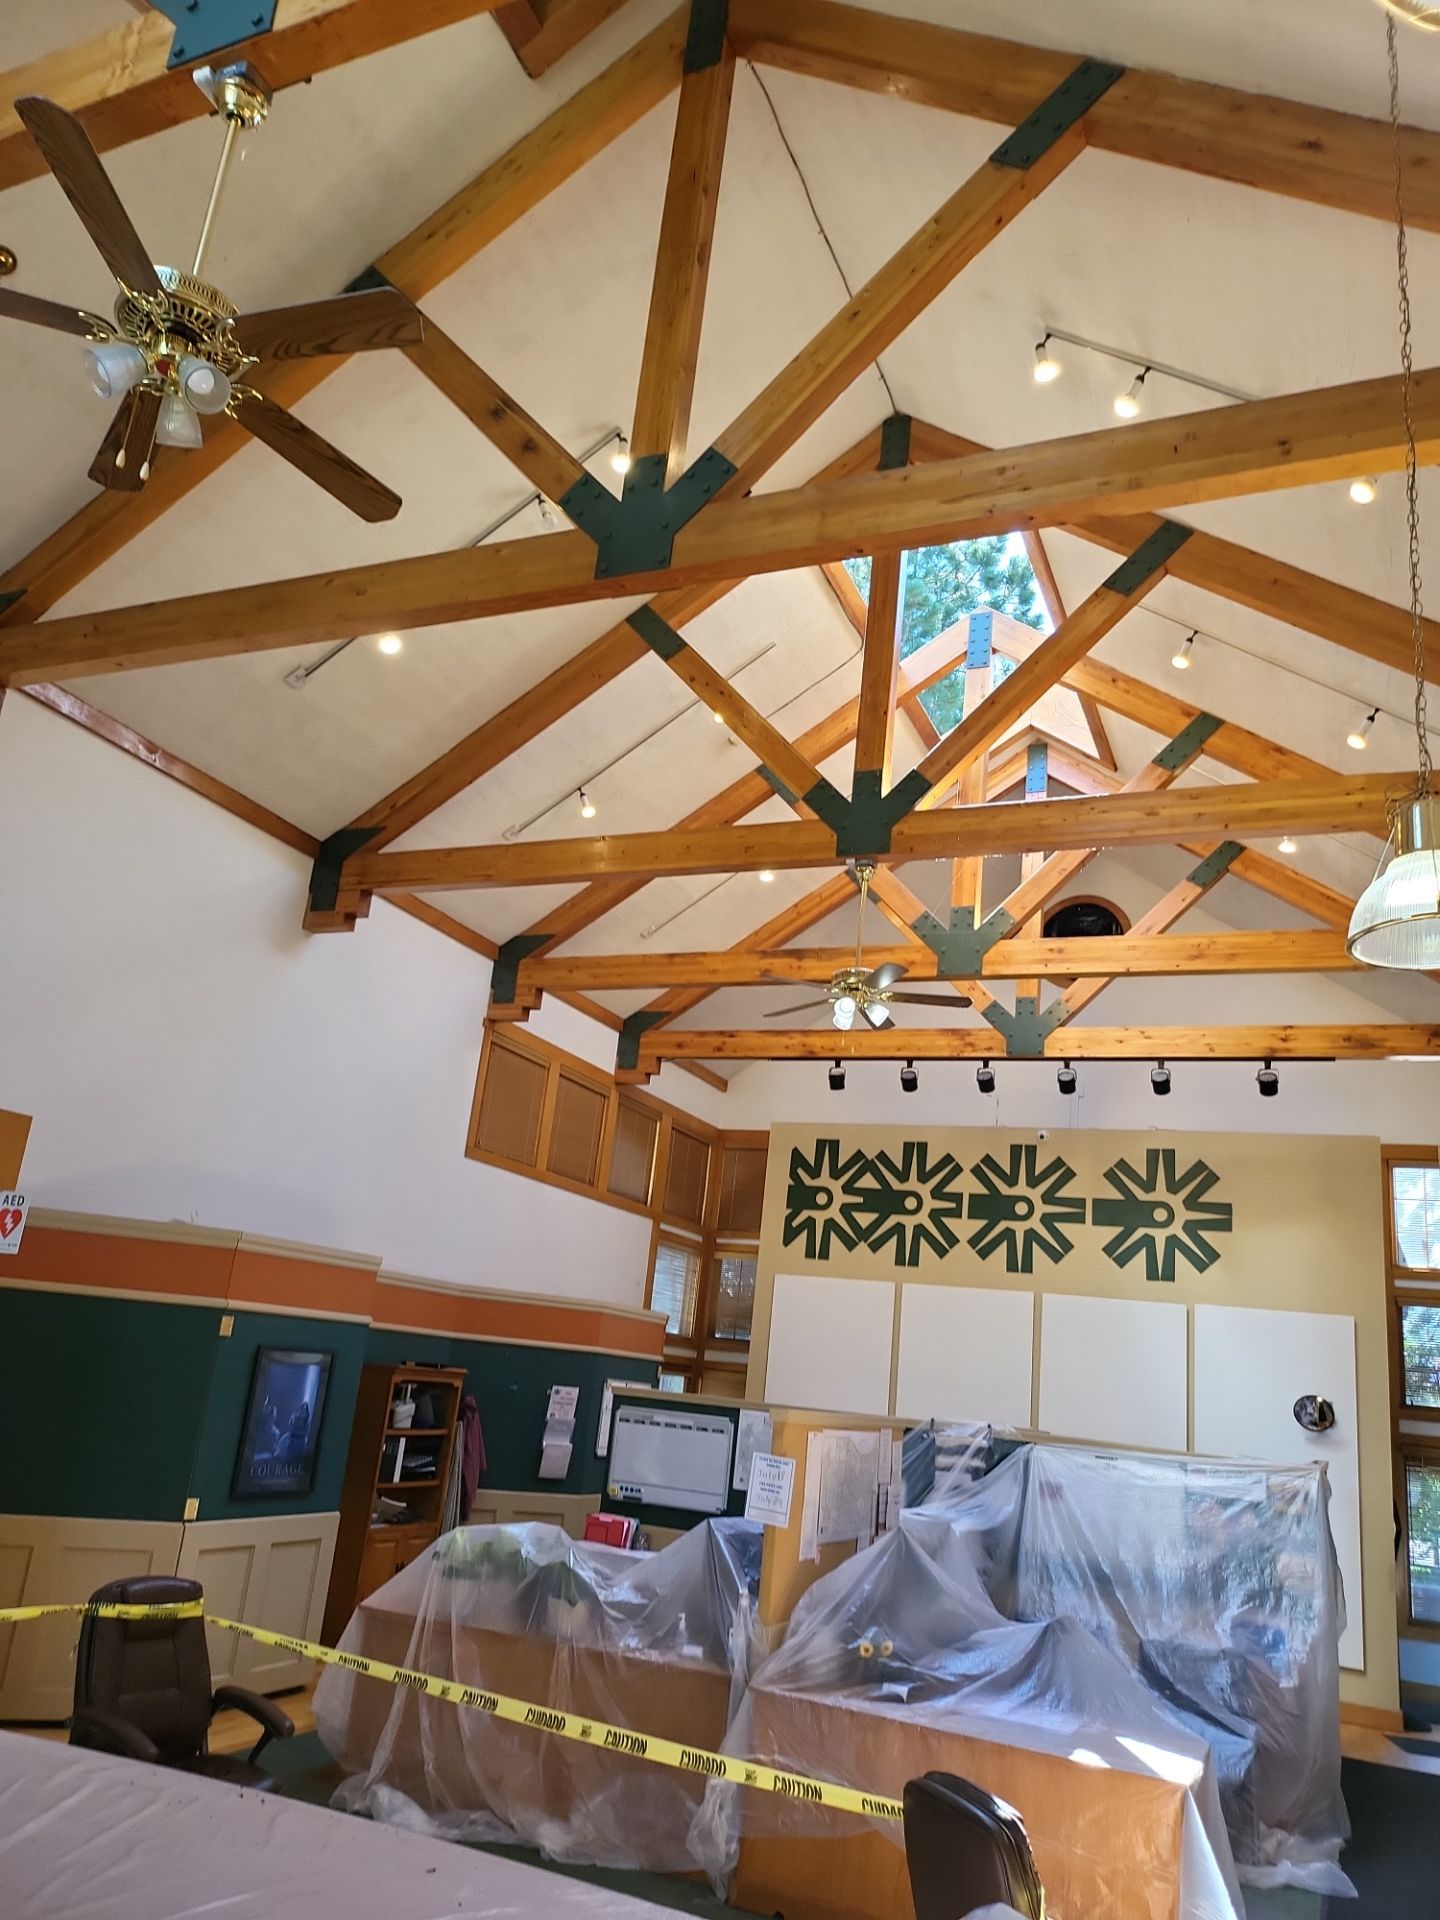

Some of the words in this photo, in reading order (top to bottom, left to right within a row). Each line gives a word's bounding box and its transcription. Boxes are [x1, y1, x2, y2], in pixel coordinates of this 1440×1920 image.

[2, 1194, 26, 1207] AED
[249, 1463, 305, 1476] COURAGE
[392, 1669, 429, 1690] CUIDADO
[460, 1689, 499, 1712] CAUTION
[524, 1707, 567, 1731] CUIDADO
[603, 1729, 648, 1756] CAUTION
[679, 1749, 727, 1777] CUIDADO
[773, 1775, 823, 1801] CAUTION
[861, 1798, 904, 1819] CUIDAD
